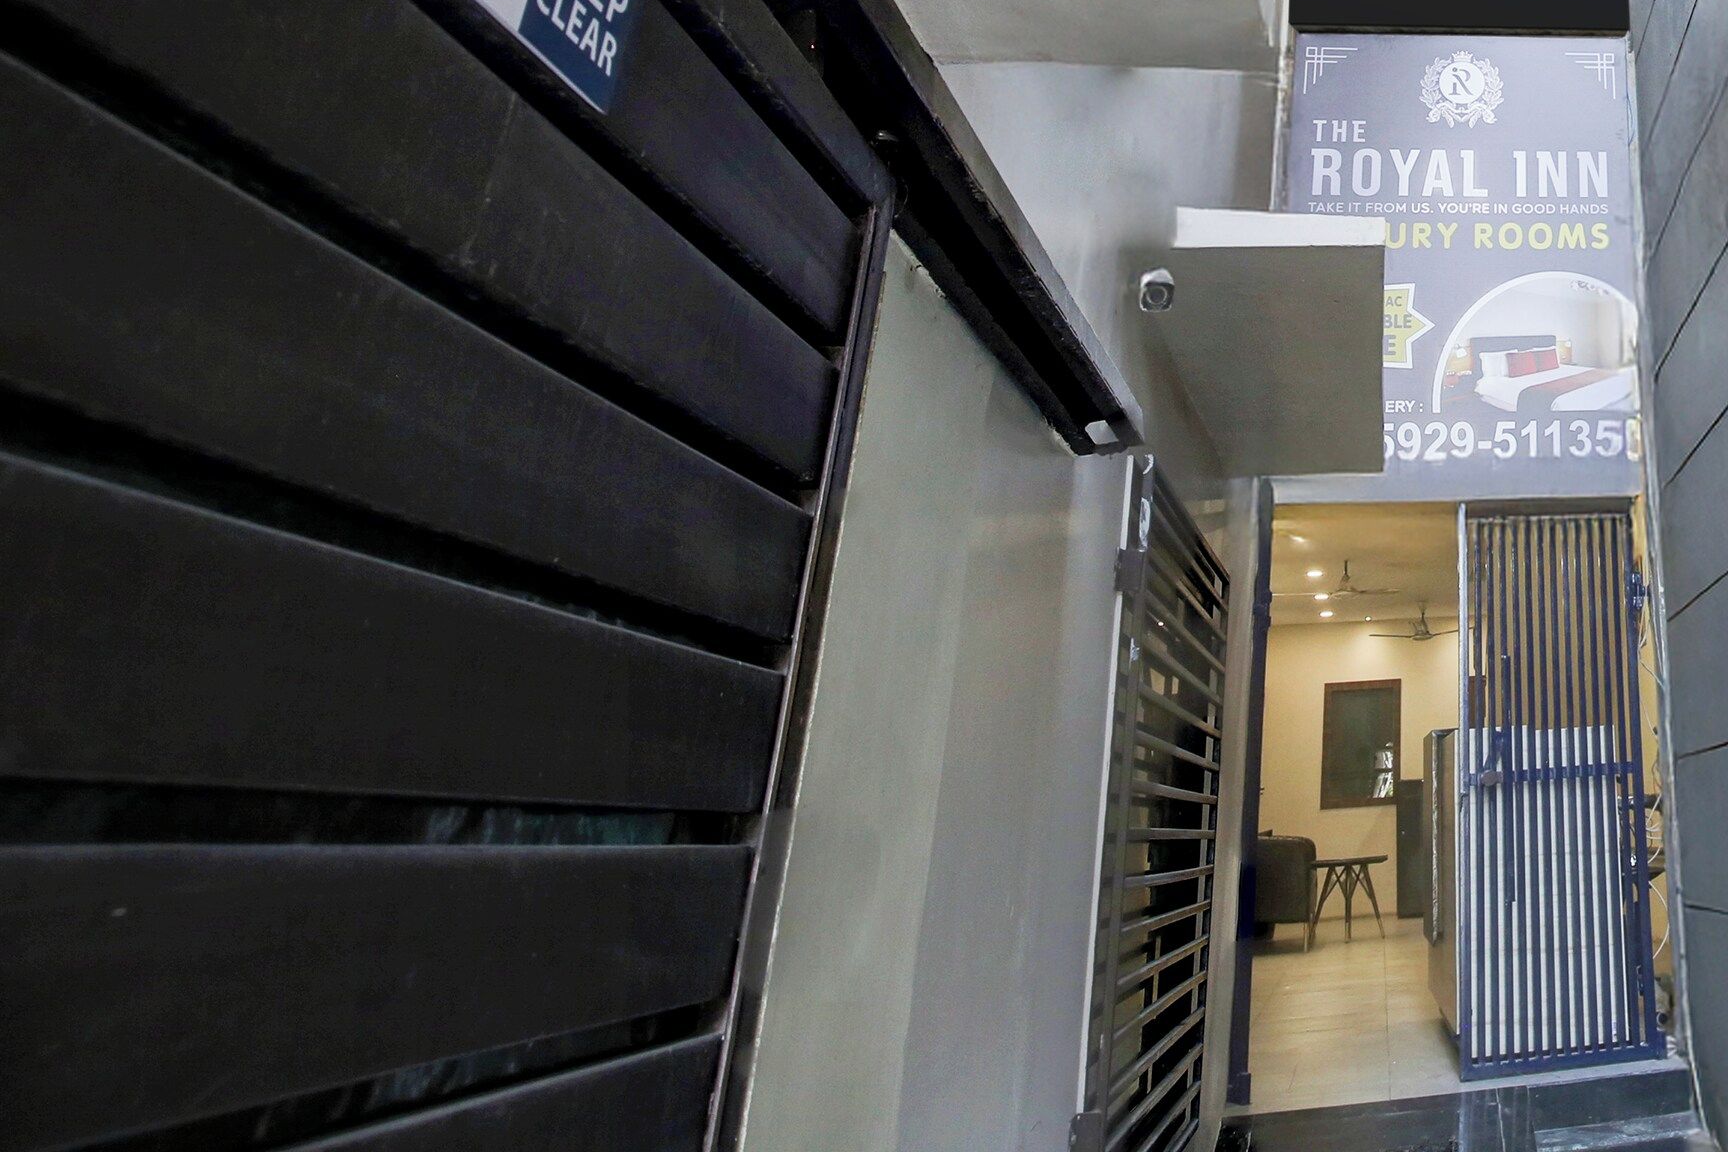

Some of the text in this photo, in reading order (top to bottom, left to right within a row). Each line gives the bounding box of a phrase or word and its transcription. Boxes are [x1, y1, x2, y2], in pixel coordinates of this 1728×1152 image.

[1313, 120, 1367, 142] THE
[1311, 148, 1608, 198] ROYAL INN
[1308, 202, 1608, 215] TAKE IT FROM US. YOU'RE IN GOOD HANDS
[1474, 222, 1610, 250] ROOMS
